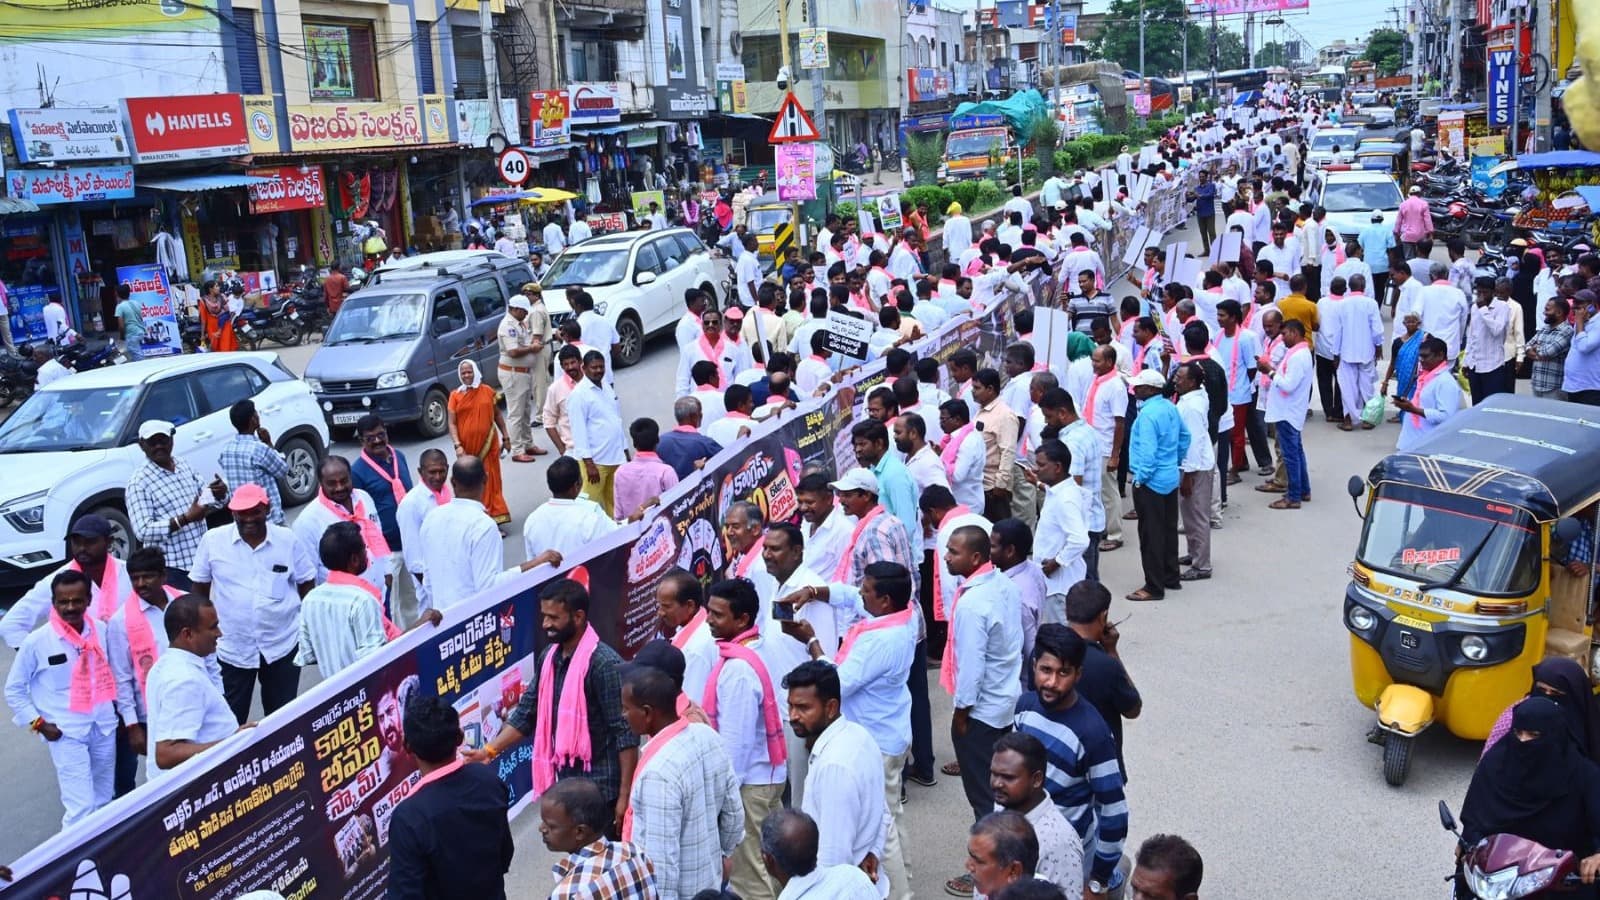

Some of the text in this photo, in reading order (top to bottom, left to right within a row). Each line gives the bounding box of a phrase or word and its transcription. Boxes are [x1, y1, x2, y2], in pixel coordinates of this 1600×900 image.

[1494, 51, 1513, 123] WINES
[168, 112, 232, 131] HAVELLS
[291, 106, 423, 143] విజయ్ సెలక్షన్స్
[505, 160, 524, 174] 40
[438, 612, 497, 661] కాంగ్రెస్‌కు
[436, 665, 461, 696] ఒక్క
[460, 654, 483, 681] ఓటు
[311, 702, 343, 732] కాంగ్రెస్
[314, 702, 374, 760] కార్మిక
[162, 798, 193, 831] డాక్టర్
[261, 734, 305, 774] ఆశయాలకు
[320, 736, 381, 793] బీమా
[388, 780, 410, 807] 150
[168, 829, 200, 857] తూట్లు
[199, 804, 235, 840] పొడిచిన
